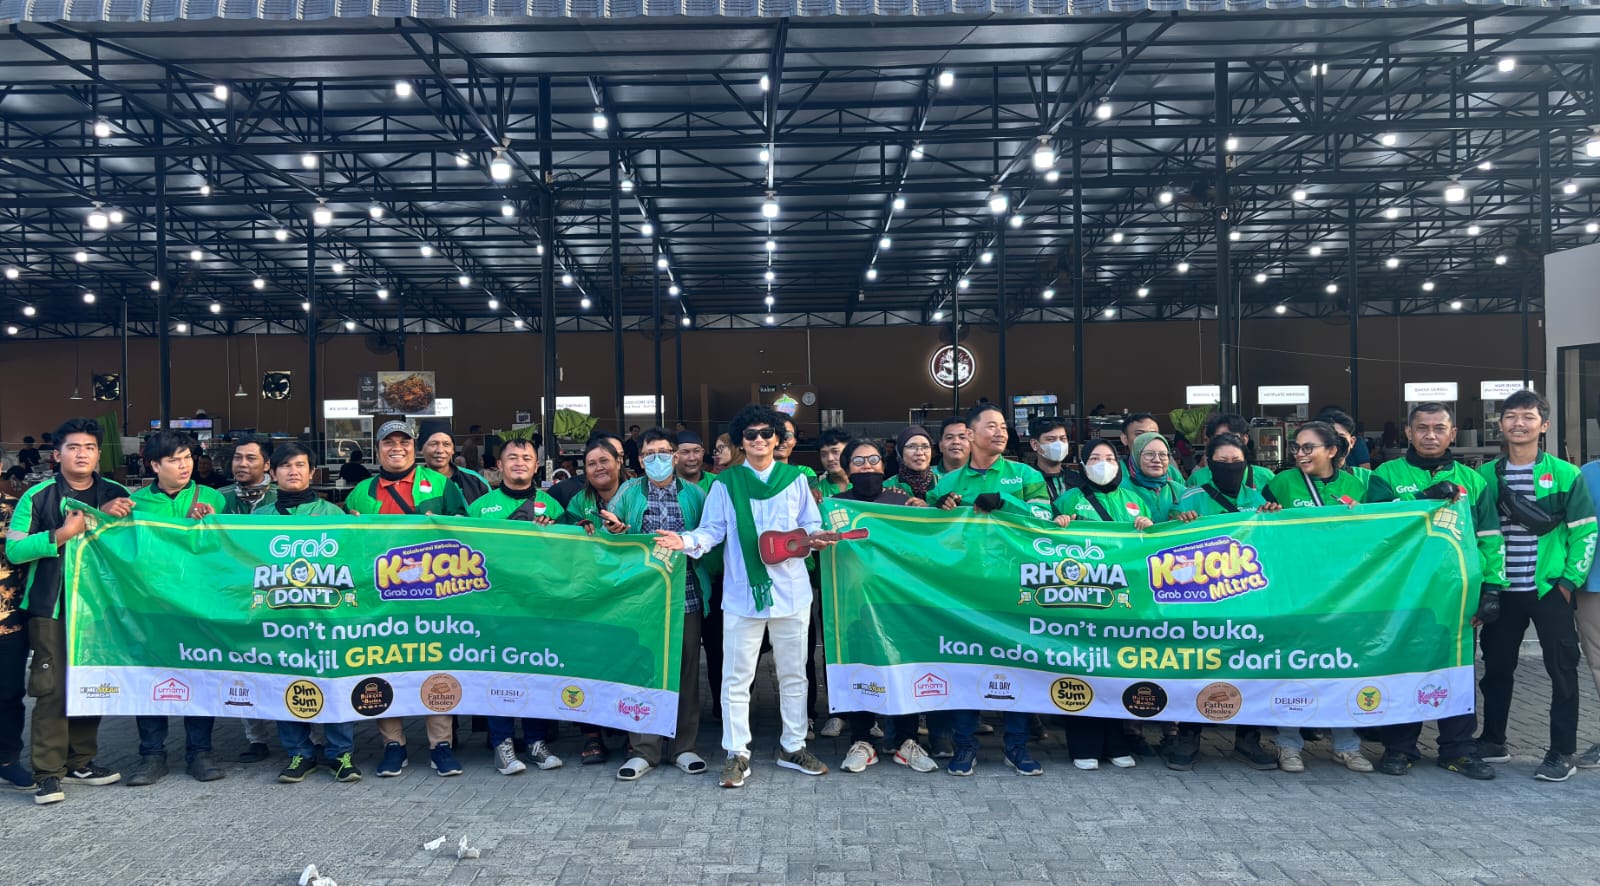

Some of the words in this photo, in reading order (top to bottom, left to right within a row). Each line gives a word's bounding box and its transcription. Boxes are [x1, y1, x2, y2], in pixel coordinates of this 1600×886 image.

[1000, 475, 1022, 485] Grab
[481, 504, 503, 514] Grab
[270, 533, 339, 557] Grab
[1033, 538, 1105, 560] Grab
[1576, 532, 1598, 572] Grab
[384, 588, 408, 598] Grab
[410, 587, 433, 596] OVO
[435, 577, 488, 598] Mitra
[1209, 574, 1266, 600] Mitra
[274, 588, 333, 605] DON'T
[1044, 587, 1106, 604] DON'T
[1157, 590, 1182, 600] Grab
[1183, 590, 1207, 600] OVO
[262, 621, 326, 640] Don't
[331, 617, 409, 640] nunda
[415, 615, 480, 638] buka,
[1029, 617, 1097, 638] Don't
[1103, 621, 1185, 641] nunda
[1192, 620, 1264, 643] buka,
[178, 642, 223, 664] kan
[228, 648, 273, 667] ada
[277, 649, 339, 675] takjil
[344, 642, 443, 669] GRATIS
[448, 643, 496, 664] dari
[501, 646, 565, 668] Grab.
[938, 636, 983, 657] kan
[990, 644, 1039, 664] ada
[1045, 646, 1111, 674] takjil
[1116, 646, 1223, 671] GRATIS
[1228, 649, 1281, 670] dari
[1288, 646, 1359, 670] Grab.
[293, 683, 316, 697] Dim
[989, 681, 998, 690] ALL
[999, 681, 1011, 691] DAY
[1059, 680, 1085, 691] Dim
[428, 692, 455, 700] Fathan
[490, 689, 519, 697] DELISH
[1058, 689, 1086, 701] Sum
[292, 695, 317, 707] Sum
[1203, 701, 1234, 709] Fathan
[1274, 697, 1308, 705] DELISH
